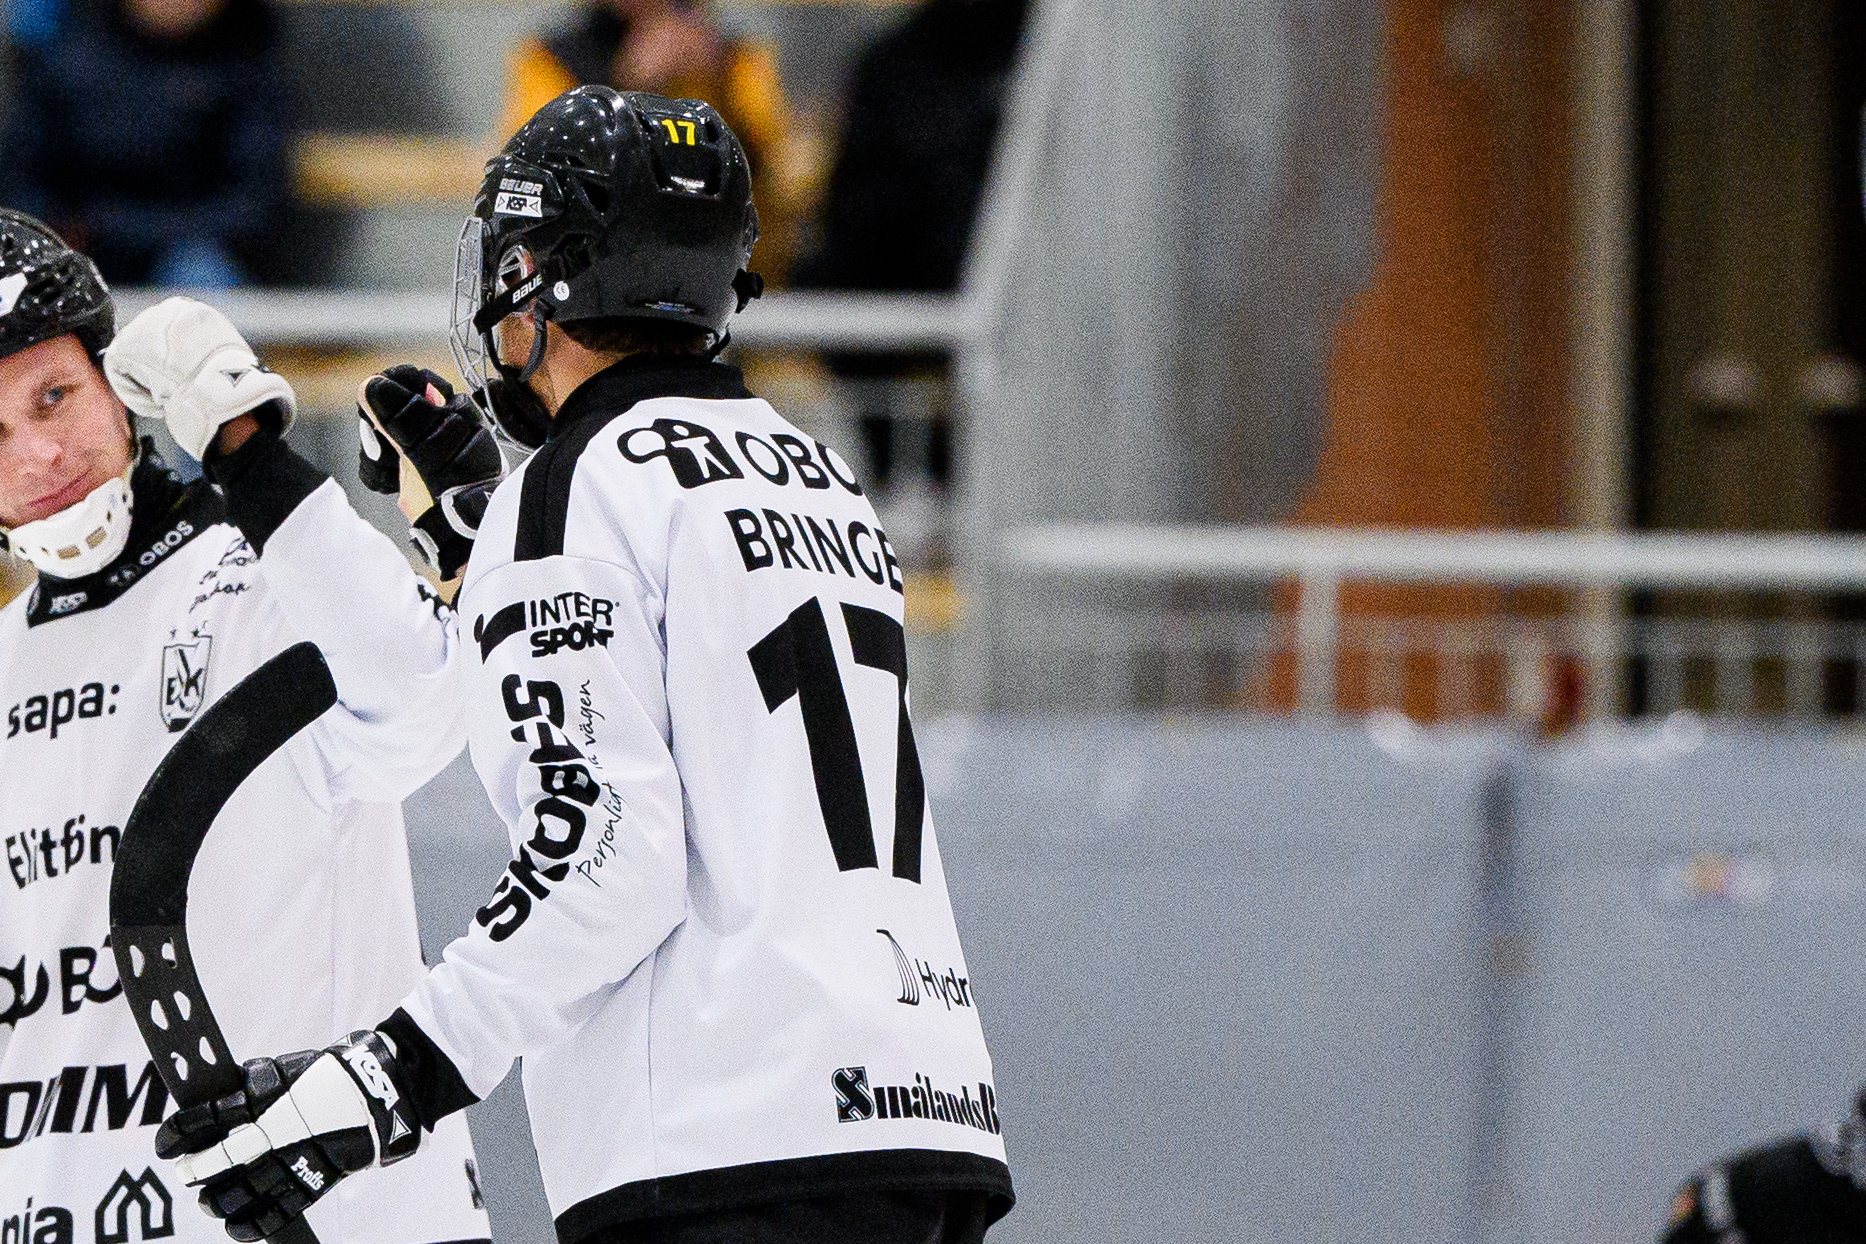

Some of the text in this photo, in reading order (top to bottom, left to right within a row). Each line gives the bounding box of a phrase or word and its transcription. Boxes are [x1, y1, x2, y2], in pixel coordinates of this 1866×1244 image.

[662, 119, 695, 146] 17
[530, 592, 615, 628] INTER
[7, 682, 120, 740] sapa:
[584, 679, 606, 747] vägen
[746, 595, 926, 886] 17
[915, 957, 971, 1011] Hydr
